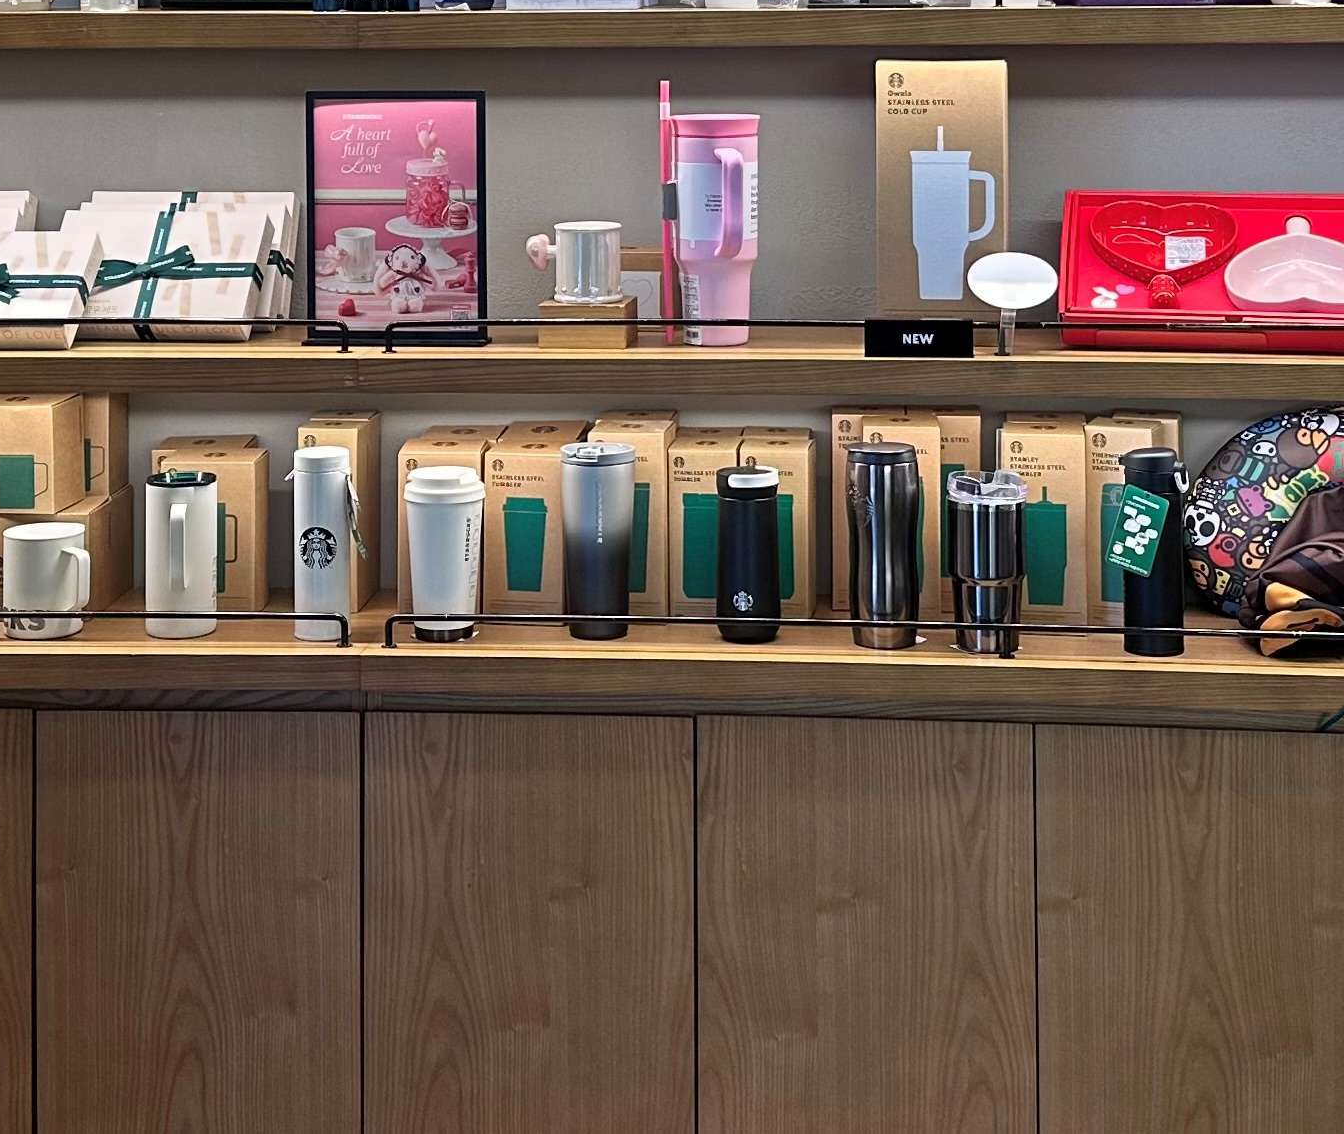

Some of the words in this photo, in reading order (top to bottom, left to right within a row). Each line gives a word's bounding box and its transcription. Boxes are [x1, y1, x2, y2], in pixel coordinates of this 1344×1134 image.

[330, 125, 354, 141] A
[356, 126, 391, 141] heart
[343, 142, 365, 157] full
[366, 142, 382, 157] of
[341, 156, 382, 174] Love
[22, 330, 64, 340] LOVE
[902, 333, 935, 345] NEW
